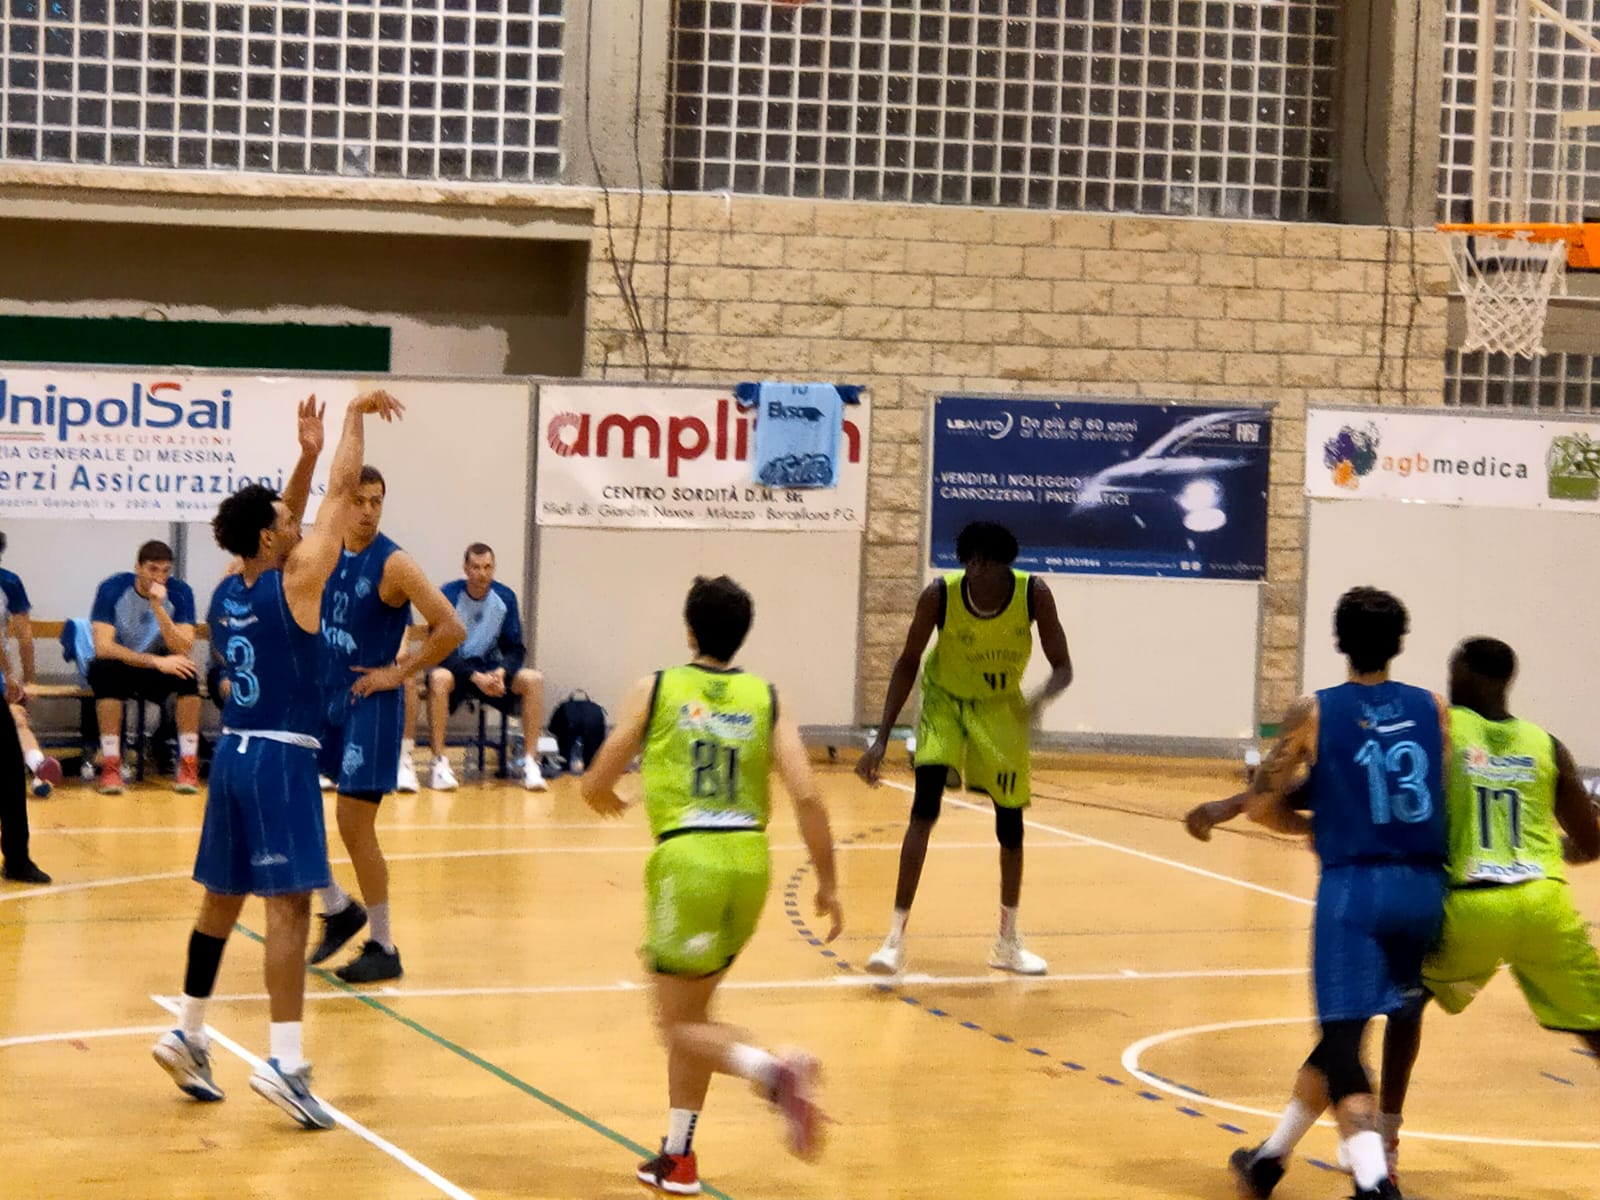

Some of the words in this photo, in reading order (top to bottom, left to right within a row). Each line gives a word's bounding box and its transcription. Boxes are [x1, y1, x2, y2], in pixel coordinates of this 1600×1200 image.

[0, 378, 233, 441] nipolSai
[77, 432, 232, 446] ASSICURAZIONI
[546, 398, 861, 478] amplin
[0, 446, 22, 460] IA
[28, 446, 126, 462] GENERALE
[133, 449, 151, 463] DI
[157, 448, 237, 465] MESSINA
[1381, 451, 1529, 480] agbmedica
[70, 463, 283, 495] Assicurazioni
[601, 485, 666, 501] CENTRO
[671, 483, 739, 503] SORDITÀ
[940, 471, 998, 487] VENDITA
[1007, 475, 1082, 489] NOLEGGIO
[940, 486, 1035, 502] CARROZZERIA
[1044, 490, 1130, 506] PNEUATICI
[226, 634, 261, 709] 3
[1353, 738, 1434, 825] 13
